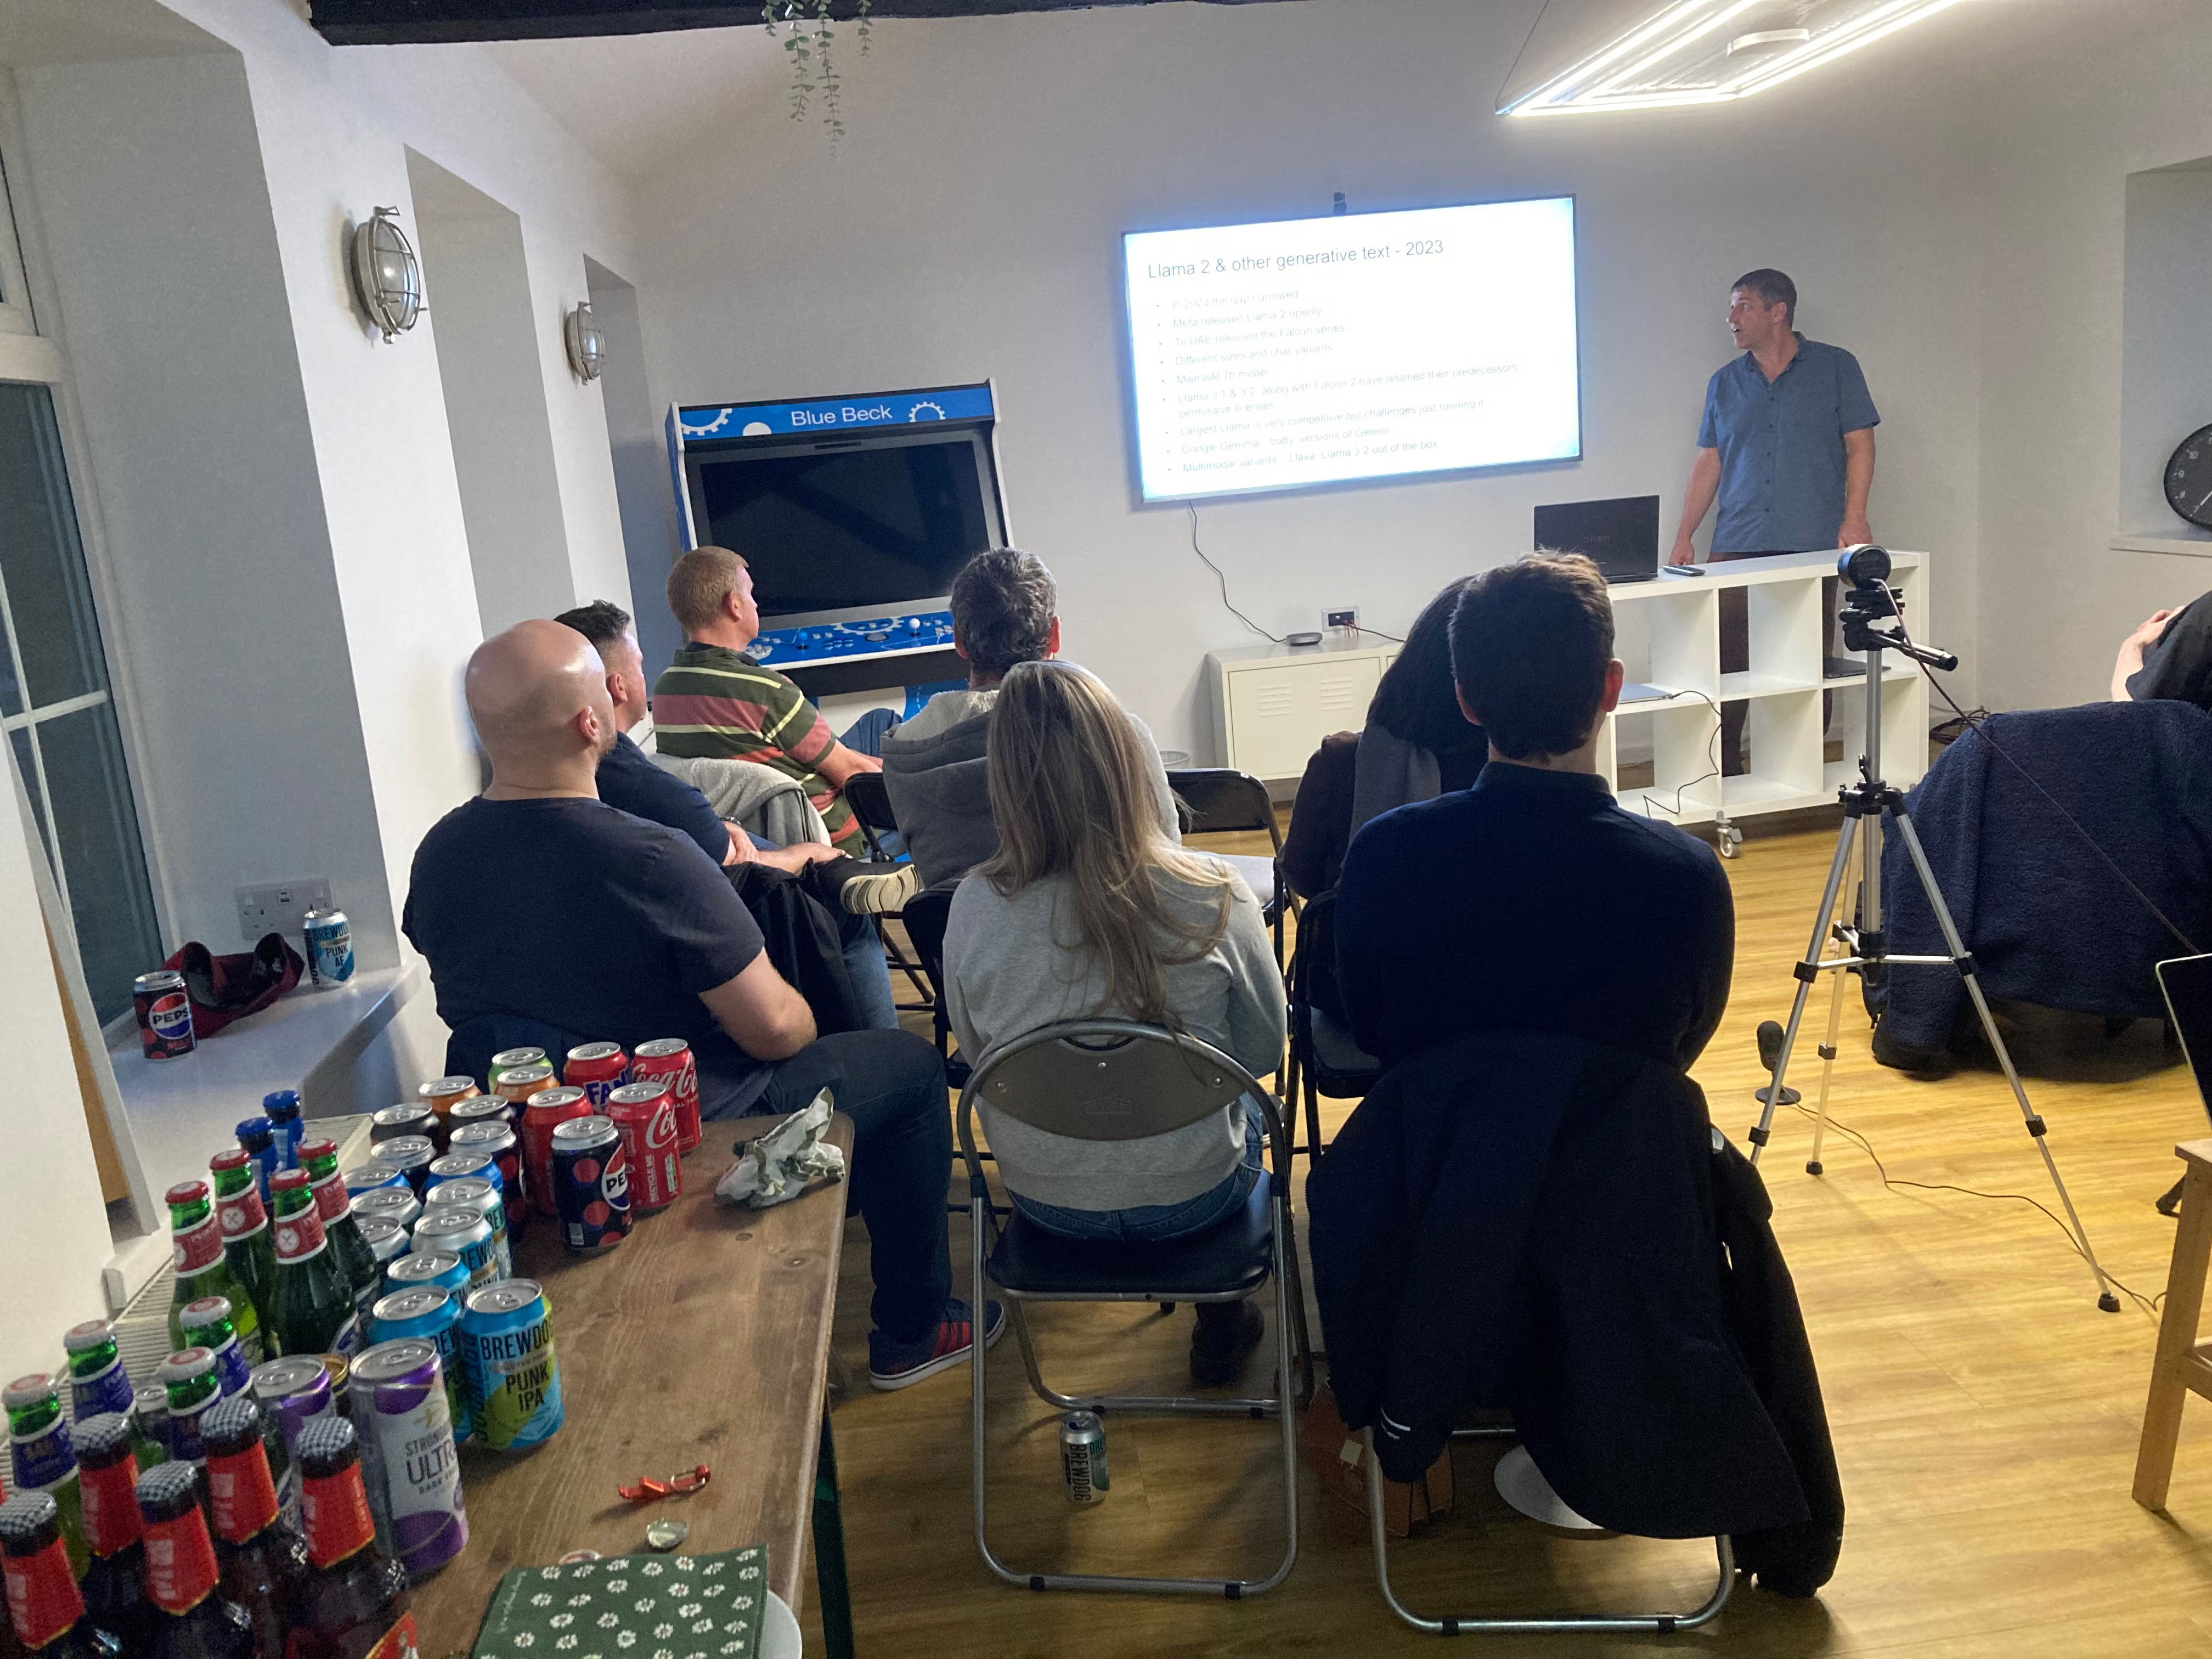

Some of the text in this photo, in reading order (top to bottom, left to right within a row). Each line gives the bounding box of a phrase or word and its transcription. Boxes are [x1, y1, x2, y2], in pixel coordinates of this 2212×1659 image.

[1148, 263, 1196, 279] Llama
[1200, 259, 1210, 274] 2
[1215, 258, 1226, 273] &
[1232, 256, 1271, 272] other
[1277, 248, 1357, 271] generative
[1363, 245, 1391, 260] text
[1406, 239, 1443, 256] 2023
[1173, 306, 1322, 329] Meta released Llama 2 openly
[1215, 331, 1257, 343] released
[1261, 329, 1277, 340] the
[1279, 326, 1313, 338] Falcon
[1316, 324, 1345, 335] series
[1176, 343, 1334, 366] Different sizes and chat variants
[1177, 366, 1269, 384] MistralAI 7b model
[1178, 363, 1519, 403] Llama 31 & 32 along with Falcon 2 have retained their predecessors
[791, 404, 893, 427] Blue Beck
[1180, 400, 1275, 419] permissive licenses
[1180, 425, 1217, 437] Largest
[1220, 422, 1250, 433] Llama
[1253, 420, 1261, 430] is
[1265, 419, 1285, 429] very
[1288, 413, 1344, 427] competitive
[1346, 410, 1362, 420] but
[1364, 405, 1417, 419] challenges
[1419, 403, 1437, 416] just
[1439, 400, 1476, 412] running
[1182, 425, 1390, 455] Google Gemma baby versions of Gemini
[1183, 439, 1438, 473] Multimodal variants Llava Llama 32 out of the box
[2188, 450, 2199, 460] 10
[2177, 470, 2185, 479] 9
[2180, 490, 2186, 499] 8
[325, 943, 349, 957] PUNK
[335, 956, 345, 968] AF
[153, 1007, 189, 1025] PEPS
[480, 1318, 554, 1361] BREWDO
[505, 1360, 550, 1394] PUNK
[518, 1386, 545, 1413] IPA
[1070, 1444, 1092, 1501] BREWDOG
